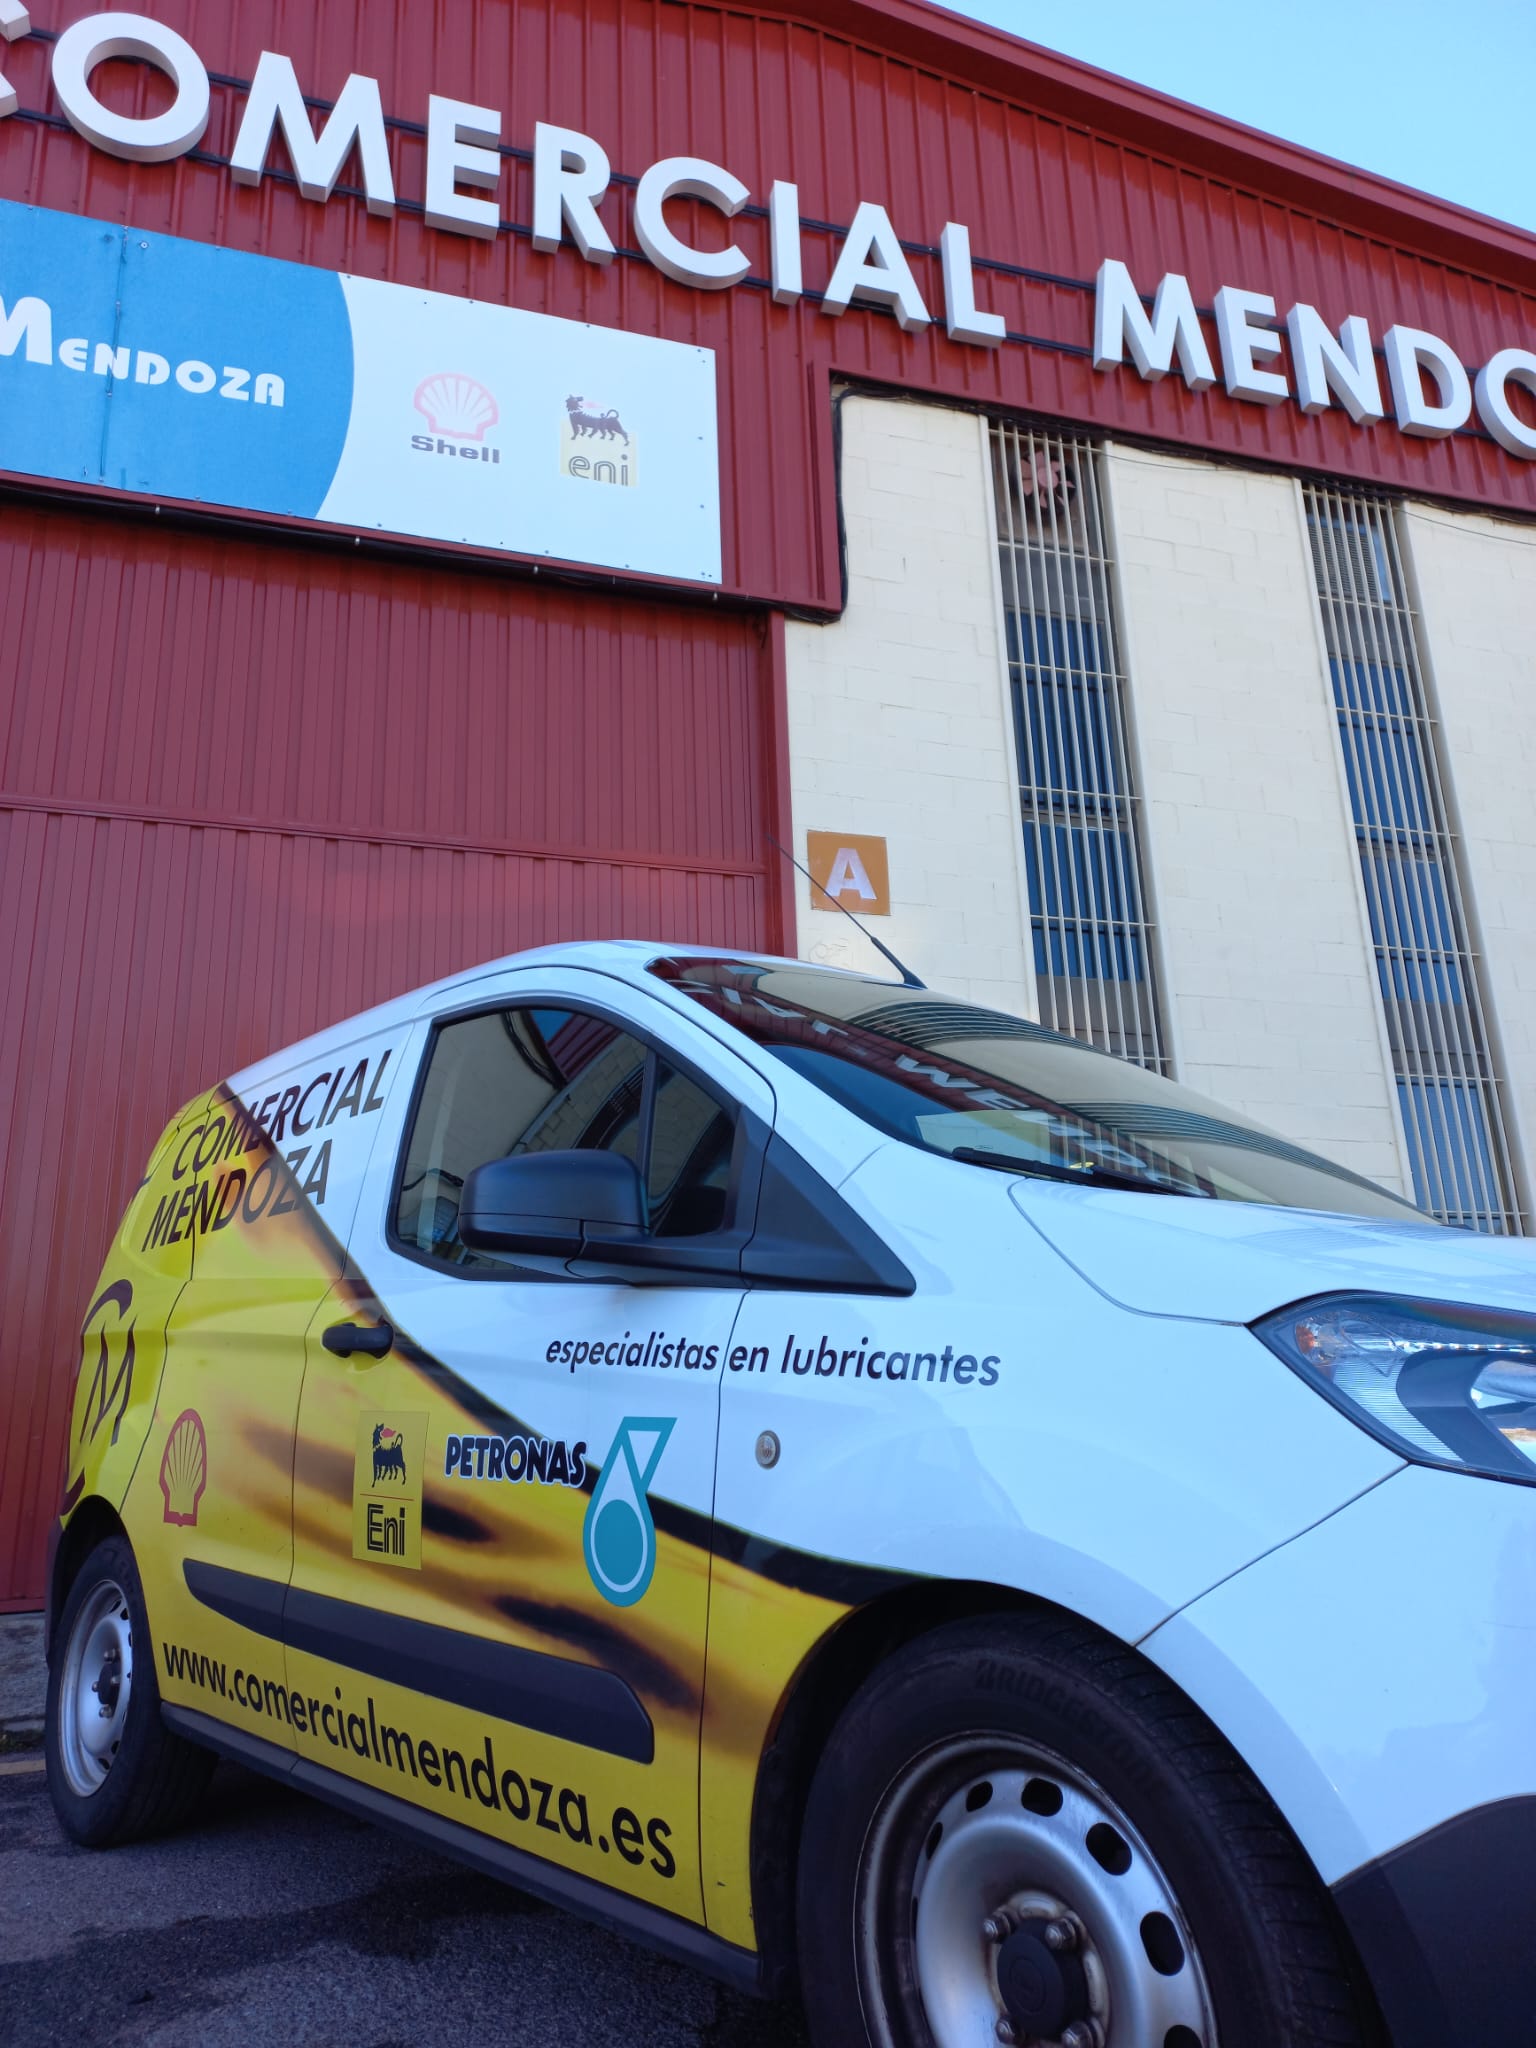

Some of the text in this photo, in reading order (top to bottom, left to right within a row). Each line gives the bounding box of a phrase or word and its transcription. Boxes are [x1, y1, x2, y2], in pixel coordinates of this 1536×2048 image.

[0, 0, 1006, 348] OMERCIAL
[411, 434, 500, 464] Shell
[568, 454, 629, 487] eni
[824, 847, 877, 900] A
[172, 1049, 393, 1181] COMERCIAL
[141, 1138, 333, 1252] MENDOZA
[545, 1331, 1002, 1386] especialistas en lubricantes
[444, 1434, 588, 1489] PETRONAS
[367, 1503, 406, 1556] Eni
[163, 1642, 677, 1879] www.comercialmendoza.es
